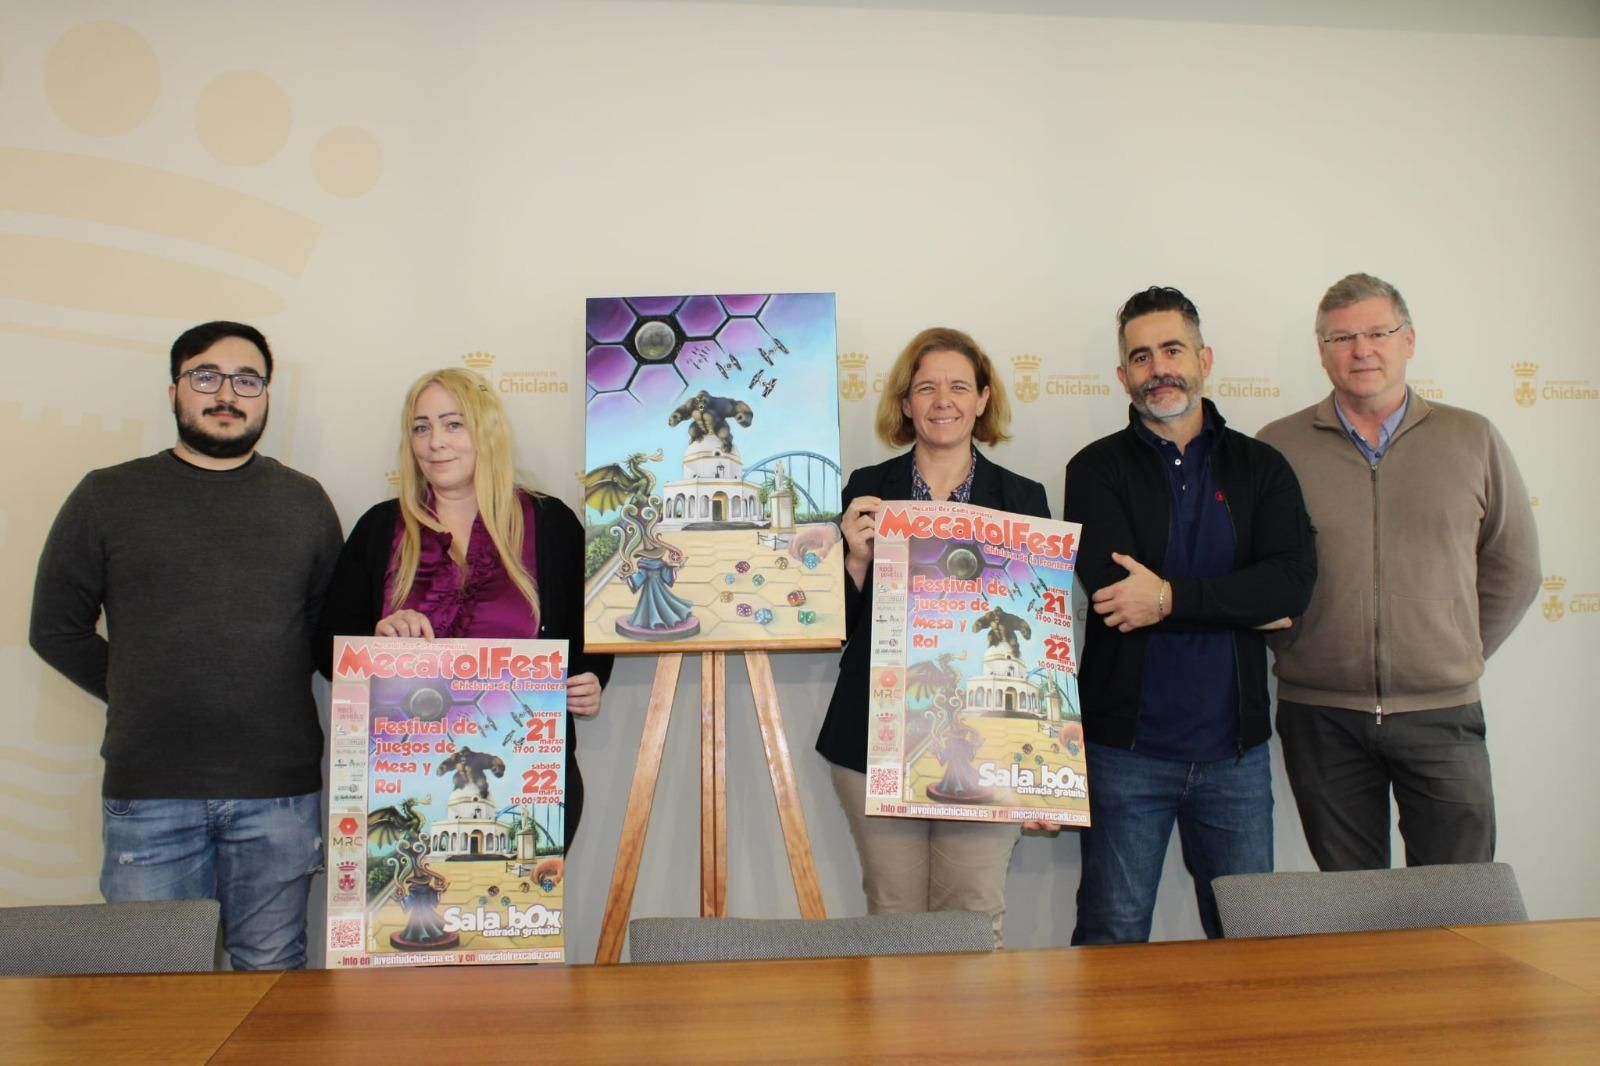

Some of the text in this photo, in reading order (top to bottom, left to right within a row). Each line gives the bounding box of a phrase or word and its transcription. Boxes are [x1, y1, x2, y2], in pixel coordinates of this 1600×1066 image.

[499, 378, 568, 393] Chiclana
[1045, 380, 1110, 396] Chiclana
[1217, 383, 1281, 398] Chiclana
[878, 508, 1076, 559] MecatolFest
[912, 575, 983, 594] Festival
[986, 578, 1008, 596] de
[913, 599, 967, 613] juegos
[970, 598, 990, 612] de
[1042, 591, 1066, 614] 21
[912, 615, 967, 632] Mesa y
[912, 635, 938, 649] Rol
[1043, 638, 1070, 661] 22
[336, 642, 564, 680] MecatolFest
[873, 688, 902, 699] MRC
[374, 717, 448, 735] Festival
[453, 717, 478, 735] de
[526, 718, 557, 742] 21
[374, 741, 431, 756] juegos
[434, 739, 456, 754] de
[374, 760, 417, 773] Mesa
[422, 762, 431, 775] y
[978, 762, 1034, 788] Sala
[374, 779, 402, 793] Rol
[522, 769, 558, 794] 22
[1016, 786, 1087, 799] entrada gratuita
[880, 803, 896, 814] info
[897, 805, 907, 814] en
[333, 837, 363, 847] MRC
[443, 905, 501, 933] Sala
[482, 925, 561, 938] entrada gratuita
[342, 956, 358, 966] info
[360, 956, 370, 965] en
[458, 953, 463, 963] y
[465, 952, 476, 962] en
